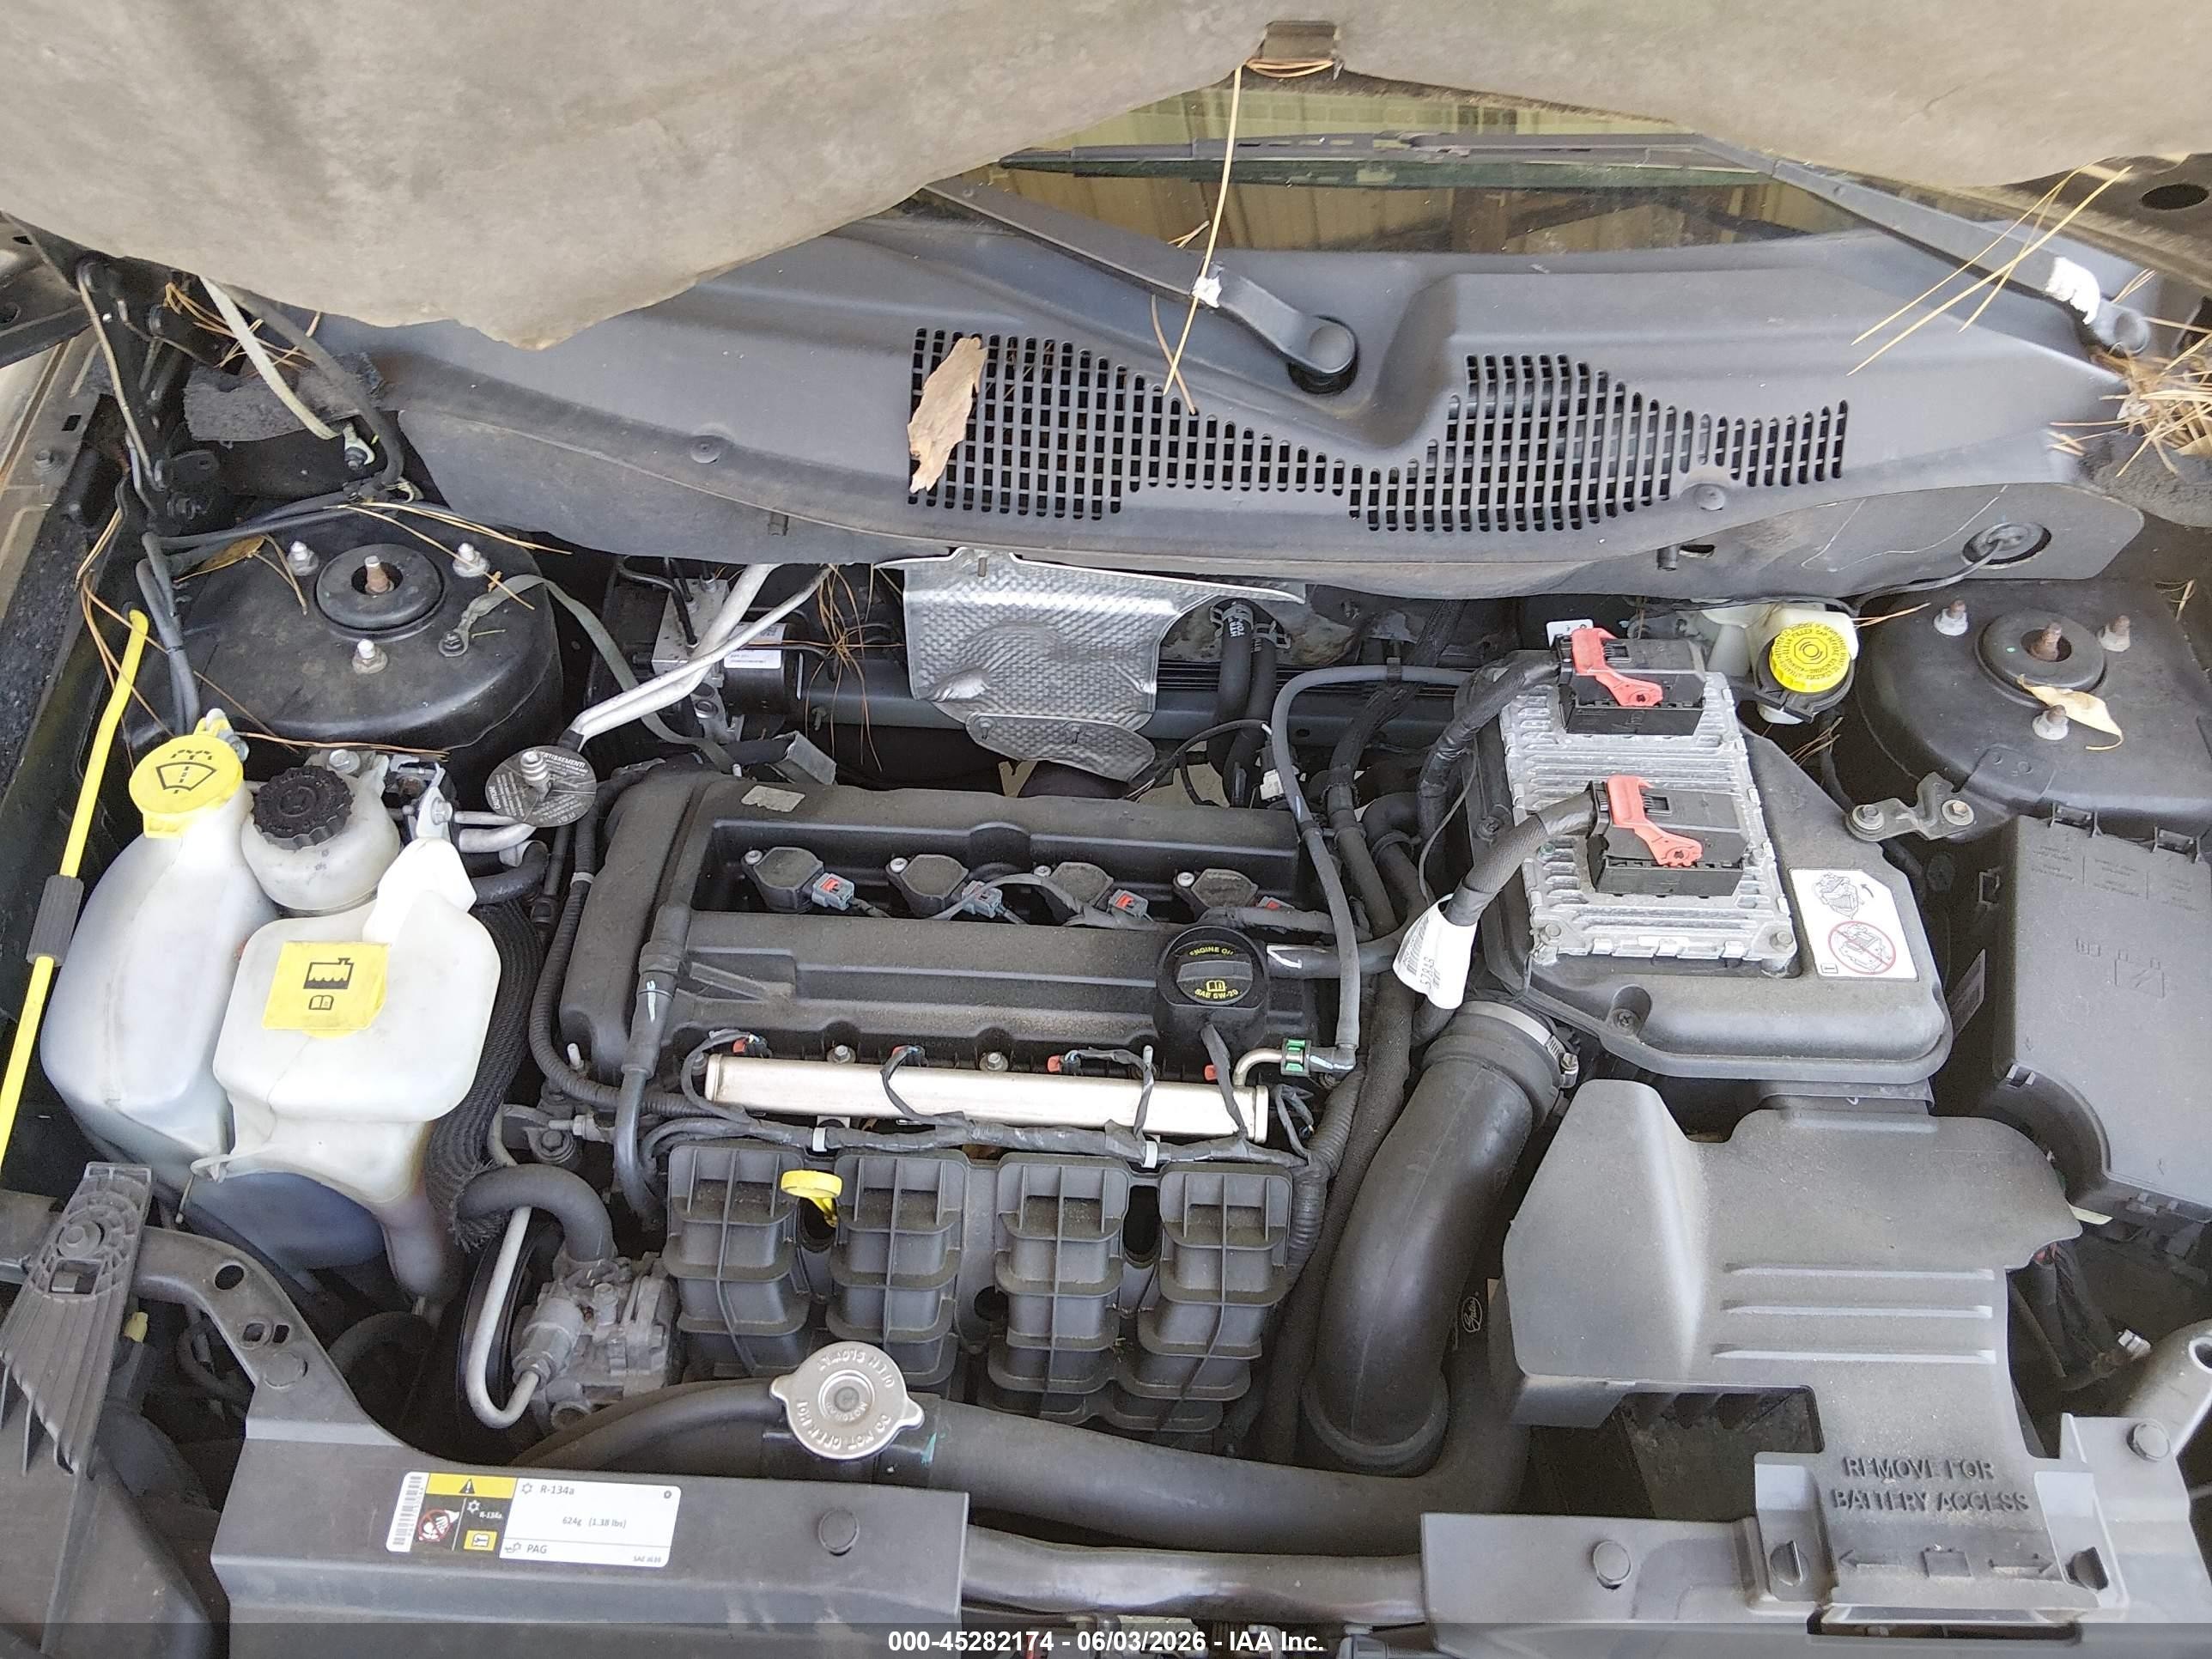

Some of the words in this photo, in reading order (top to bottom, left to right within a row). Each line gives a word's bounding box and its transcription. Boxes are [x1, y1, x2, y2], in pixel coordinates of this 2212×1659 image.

[1188, 945, 1220, 957] ENGINE
[1194, 989, 1212, 999] SAE
[1212, 989, 1239, 1000] 5W-20
[875, 1414, 893, 1434] DO
[847, 1433, 875, 1450] NOT
[1843, 1455, 1943, 1479] REMOVE
[1947, 1459, 1995, 1480] FOR
[539, 1484, 575, 1497] R-134a
[1832, 1488, 1929, 1512] BATTERY
[1936, 1491, 2032, 1513] ACCESS
[562, 1516, 583, 1528] 624g
[588, 1516, 610, 1528] (1.38
[611, 1517, 627, 1528] lbs)
[526, 1543, 548, 1554] PAG
